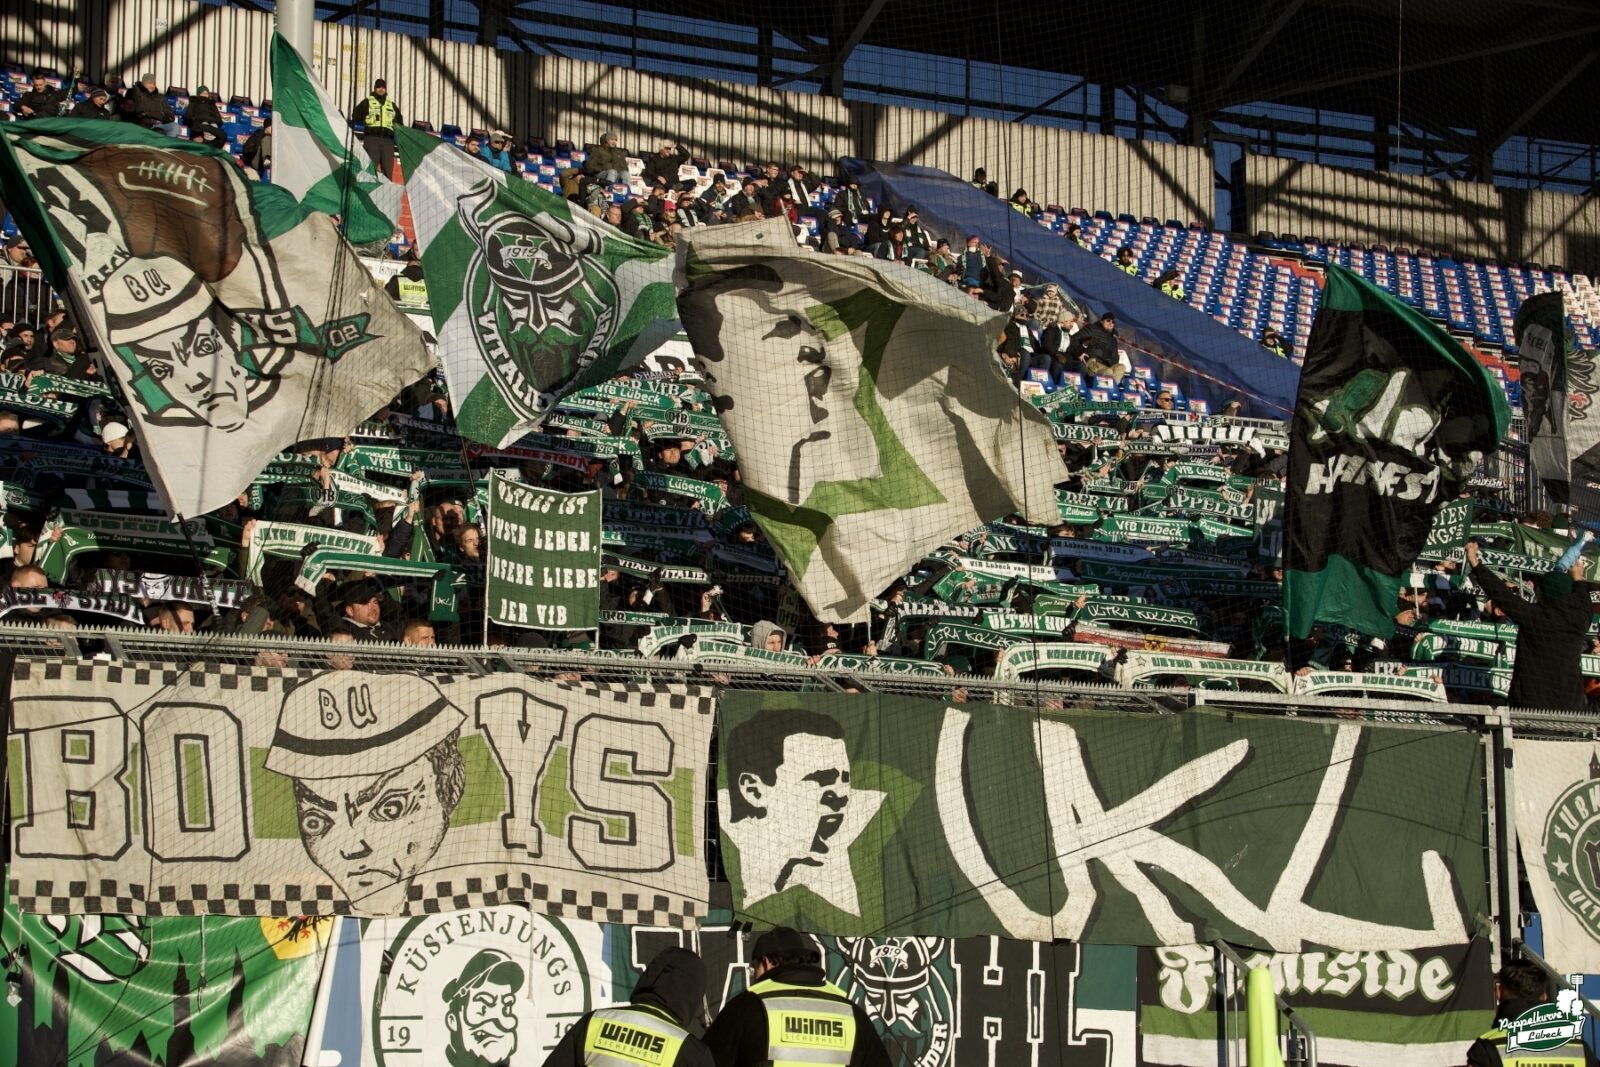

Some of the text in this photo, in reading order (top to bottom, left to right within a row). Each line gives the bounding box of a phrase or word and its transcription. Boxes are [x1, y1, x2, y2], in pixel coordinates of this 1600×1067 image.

[505, 246, 539, 258] 1919
[122, 267, 171, 303] BU
[329, 323, 361, 348] 02
[595, 384, 662, 405] VfB Lübeck
[568, 417, 587, 428] seit
[595, 444, 614, 455] 1919
[369, 456, 393, 469] VfB
[1176, 464, 1195, 476] VfB
[669, 479, 708, 495] Lübeck
[498, 480, 588, 515] ULTRAS IST
[491, 515, 598, 554] UNSER LEBEN,
[1116, 519, 1183, 537] VfB Lübeck
[969, 560, 984, 569] VfB
[543, 566, 598, 589] LIEBE
[500, 597, 568, 626] DER VfB
[699, 640, 739, 655] ULTRA
[744, 648, 808, 668] KOLLEKTIV
[1151, 656, 1271, 674] ULTRA KOLLEKTIV
[1310, 674, 1438, 693] ULTRA KOLLEKTIV
[317, 683, 377, 731] BU
[395, 909, 573, 997] KÜSTENJUNGS
[875, 944, 902, 958] 1919
[387, 1025, 412, 1047] 19
[783, 1033, 844, 1046] SICHERHEIT
[597, 1039, 662, 1062] SICHERHEIT
